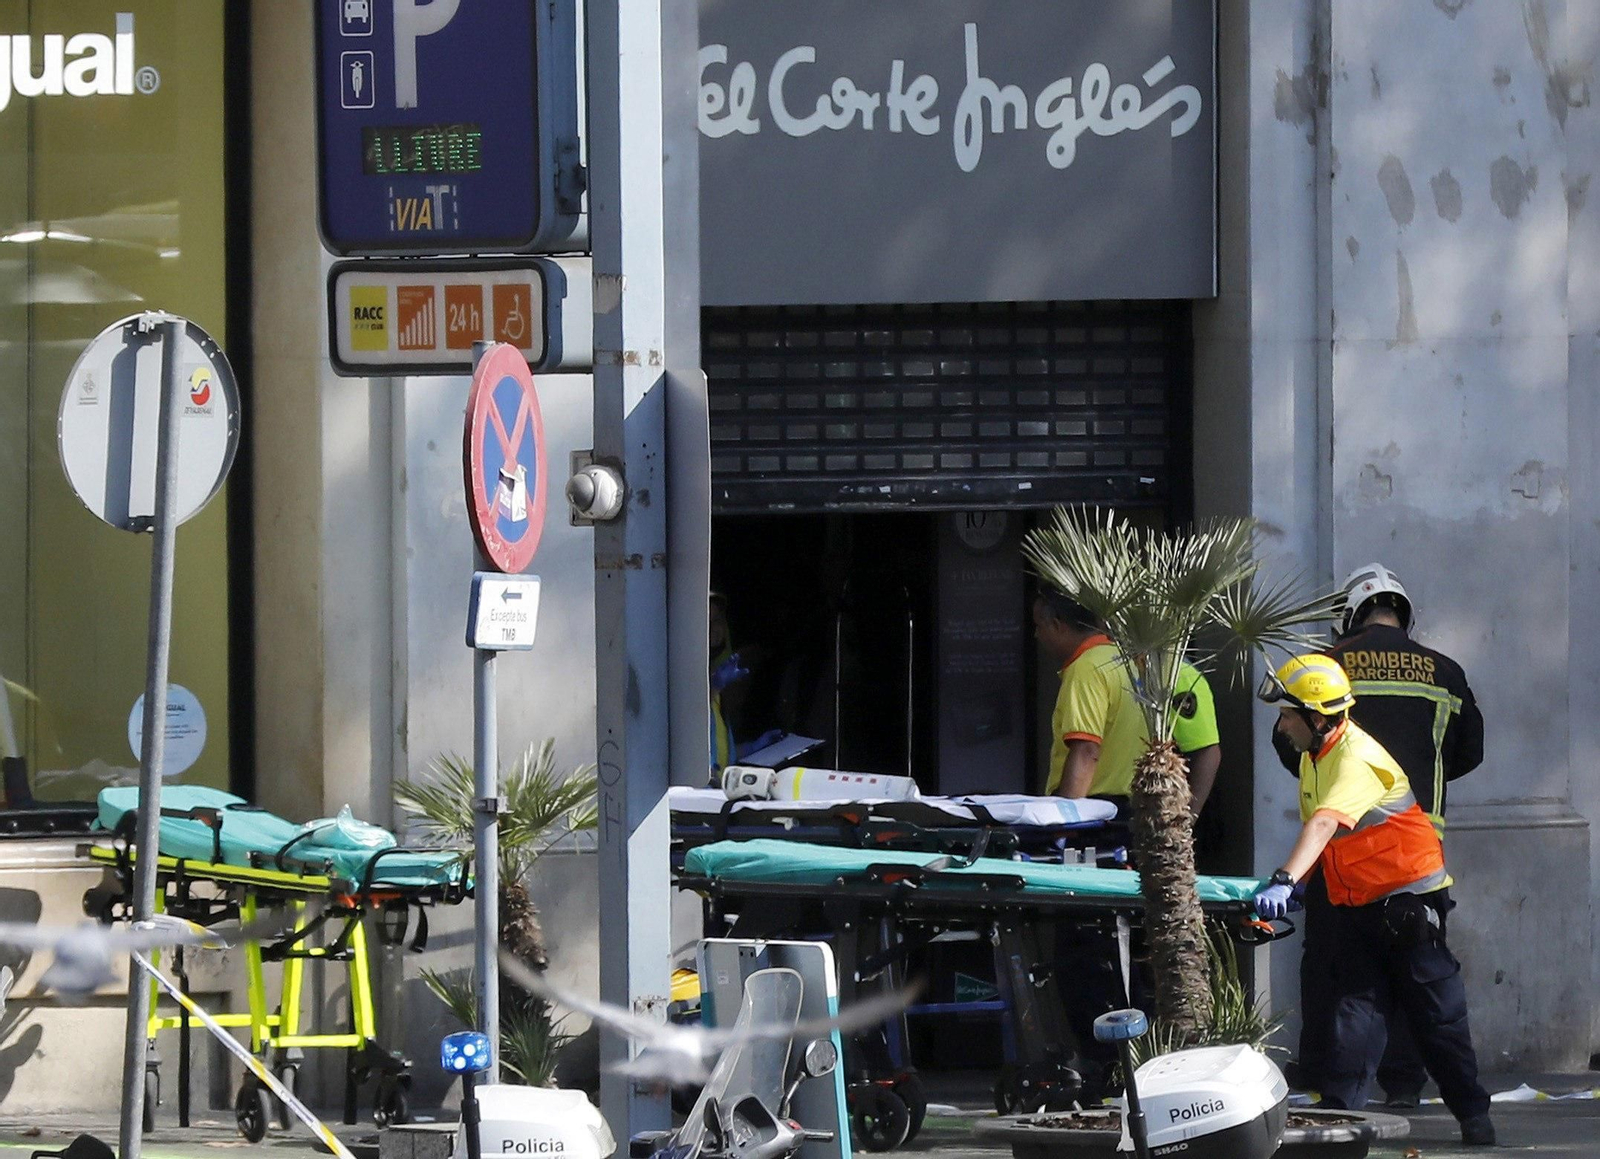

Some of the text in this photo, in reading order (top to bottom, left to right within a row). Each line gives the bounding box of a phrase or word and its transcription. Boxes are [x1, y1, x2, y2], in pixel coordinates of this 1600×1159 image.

[0, 12, 134, 112] ual
[393, 0, 460, 108] P
[698, 22, 1202, 172] El Corte Inglés
[354, 306, 384, 321] RACC
[449, 302, 480, 332] 24 h
[501, 627, 516, 642] TMB
[1343, 650, 1435, 673] BOMBERS
[1346, 668, 1435, 685] BARCELONA
[1169, 1098, 1225, 1123] Policia
[502, 1138, 565, 1154] Policia
